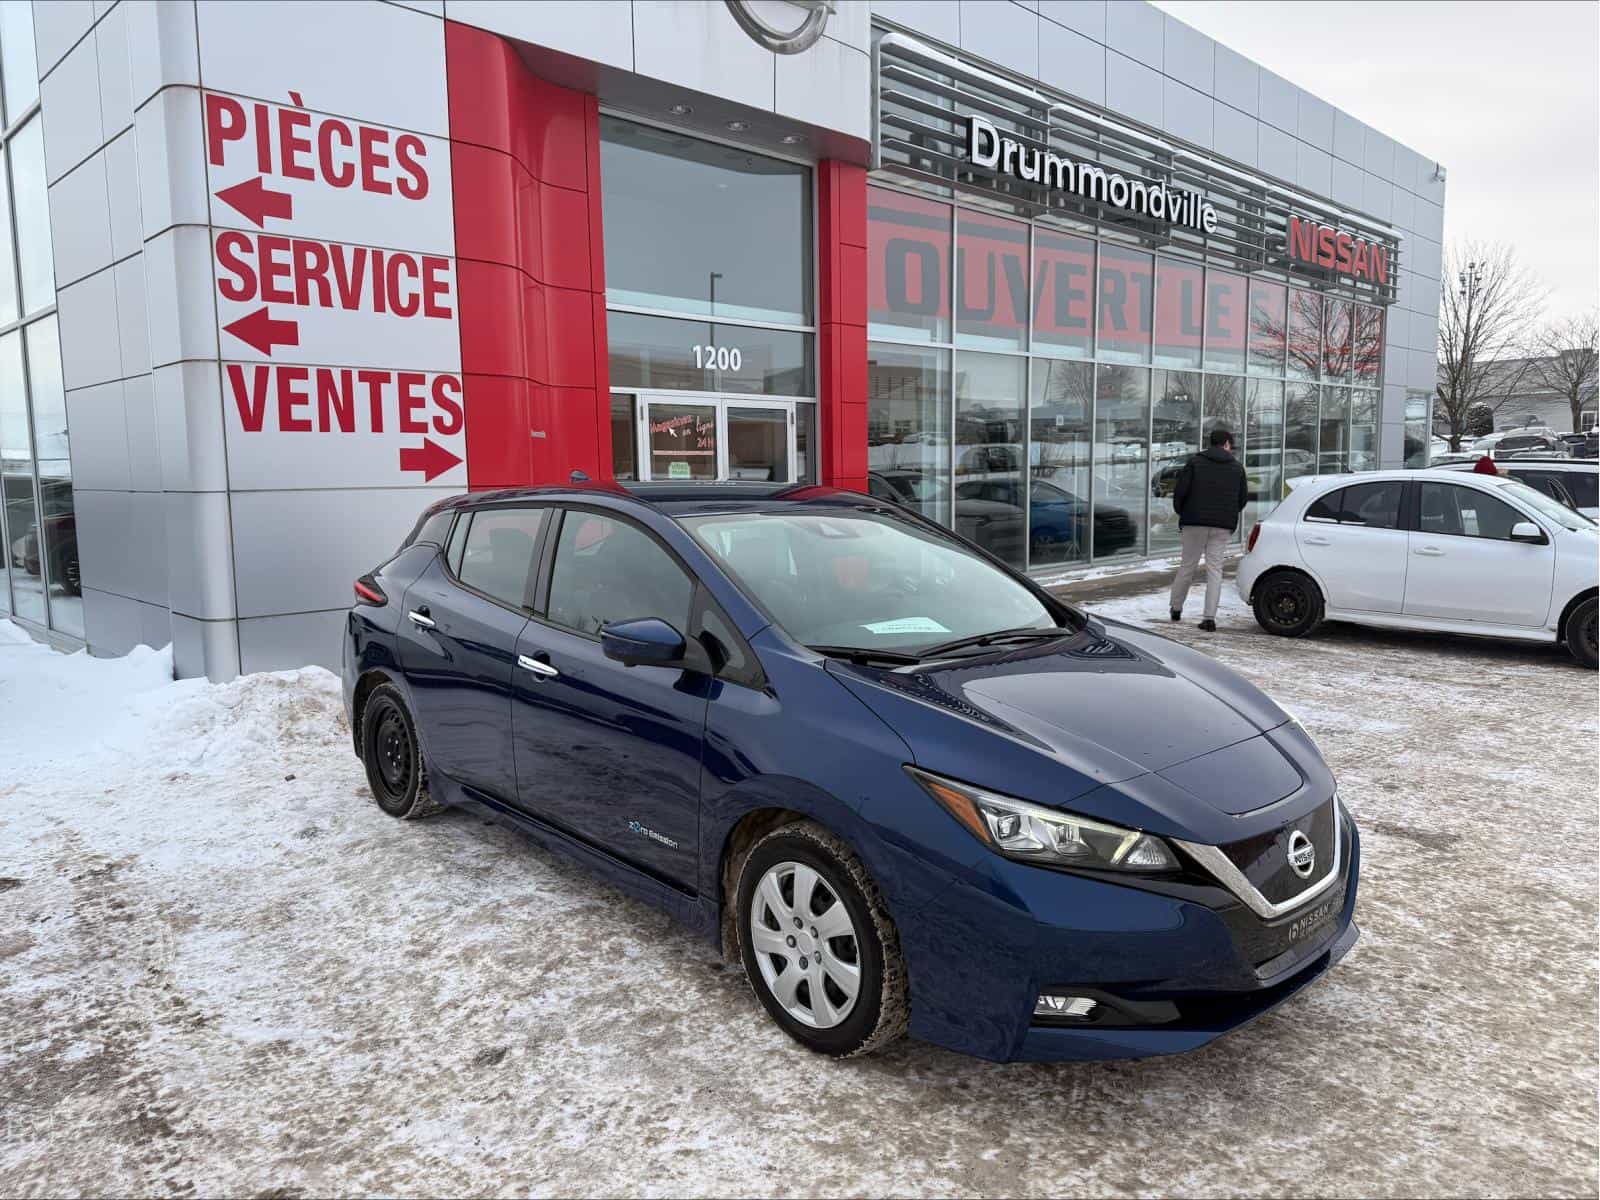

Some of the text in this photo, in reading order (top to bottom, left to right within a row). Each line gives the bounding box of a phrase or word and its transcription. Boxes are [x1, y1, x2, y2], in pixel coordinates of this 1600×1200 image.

[205, 91, 429, 200] PIÈCES
[970, 115, 1218, 234] Drummondville
[215, 231, 453, 319] SERVICE
[884, 237, 1162, 334] OUVERT
[1180, 279, 1233, 338] LE
[1288, 214, 1387, 283] NISSAN
[692, 345, 742, 371] 1200
[226, 364, 464, 435] VENTES
[1300, 903, 1329, 930] NISSAN
